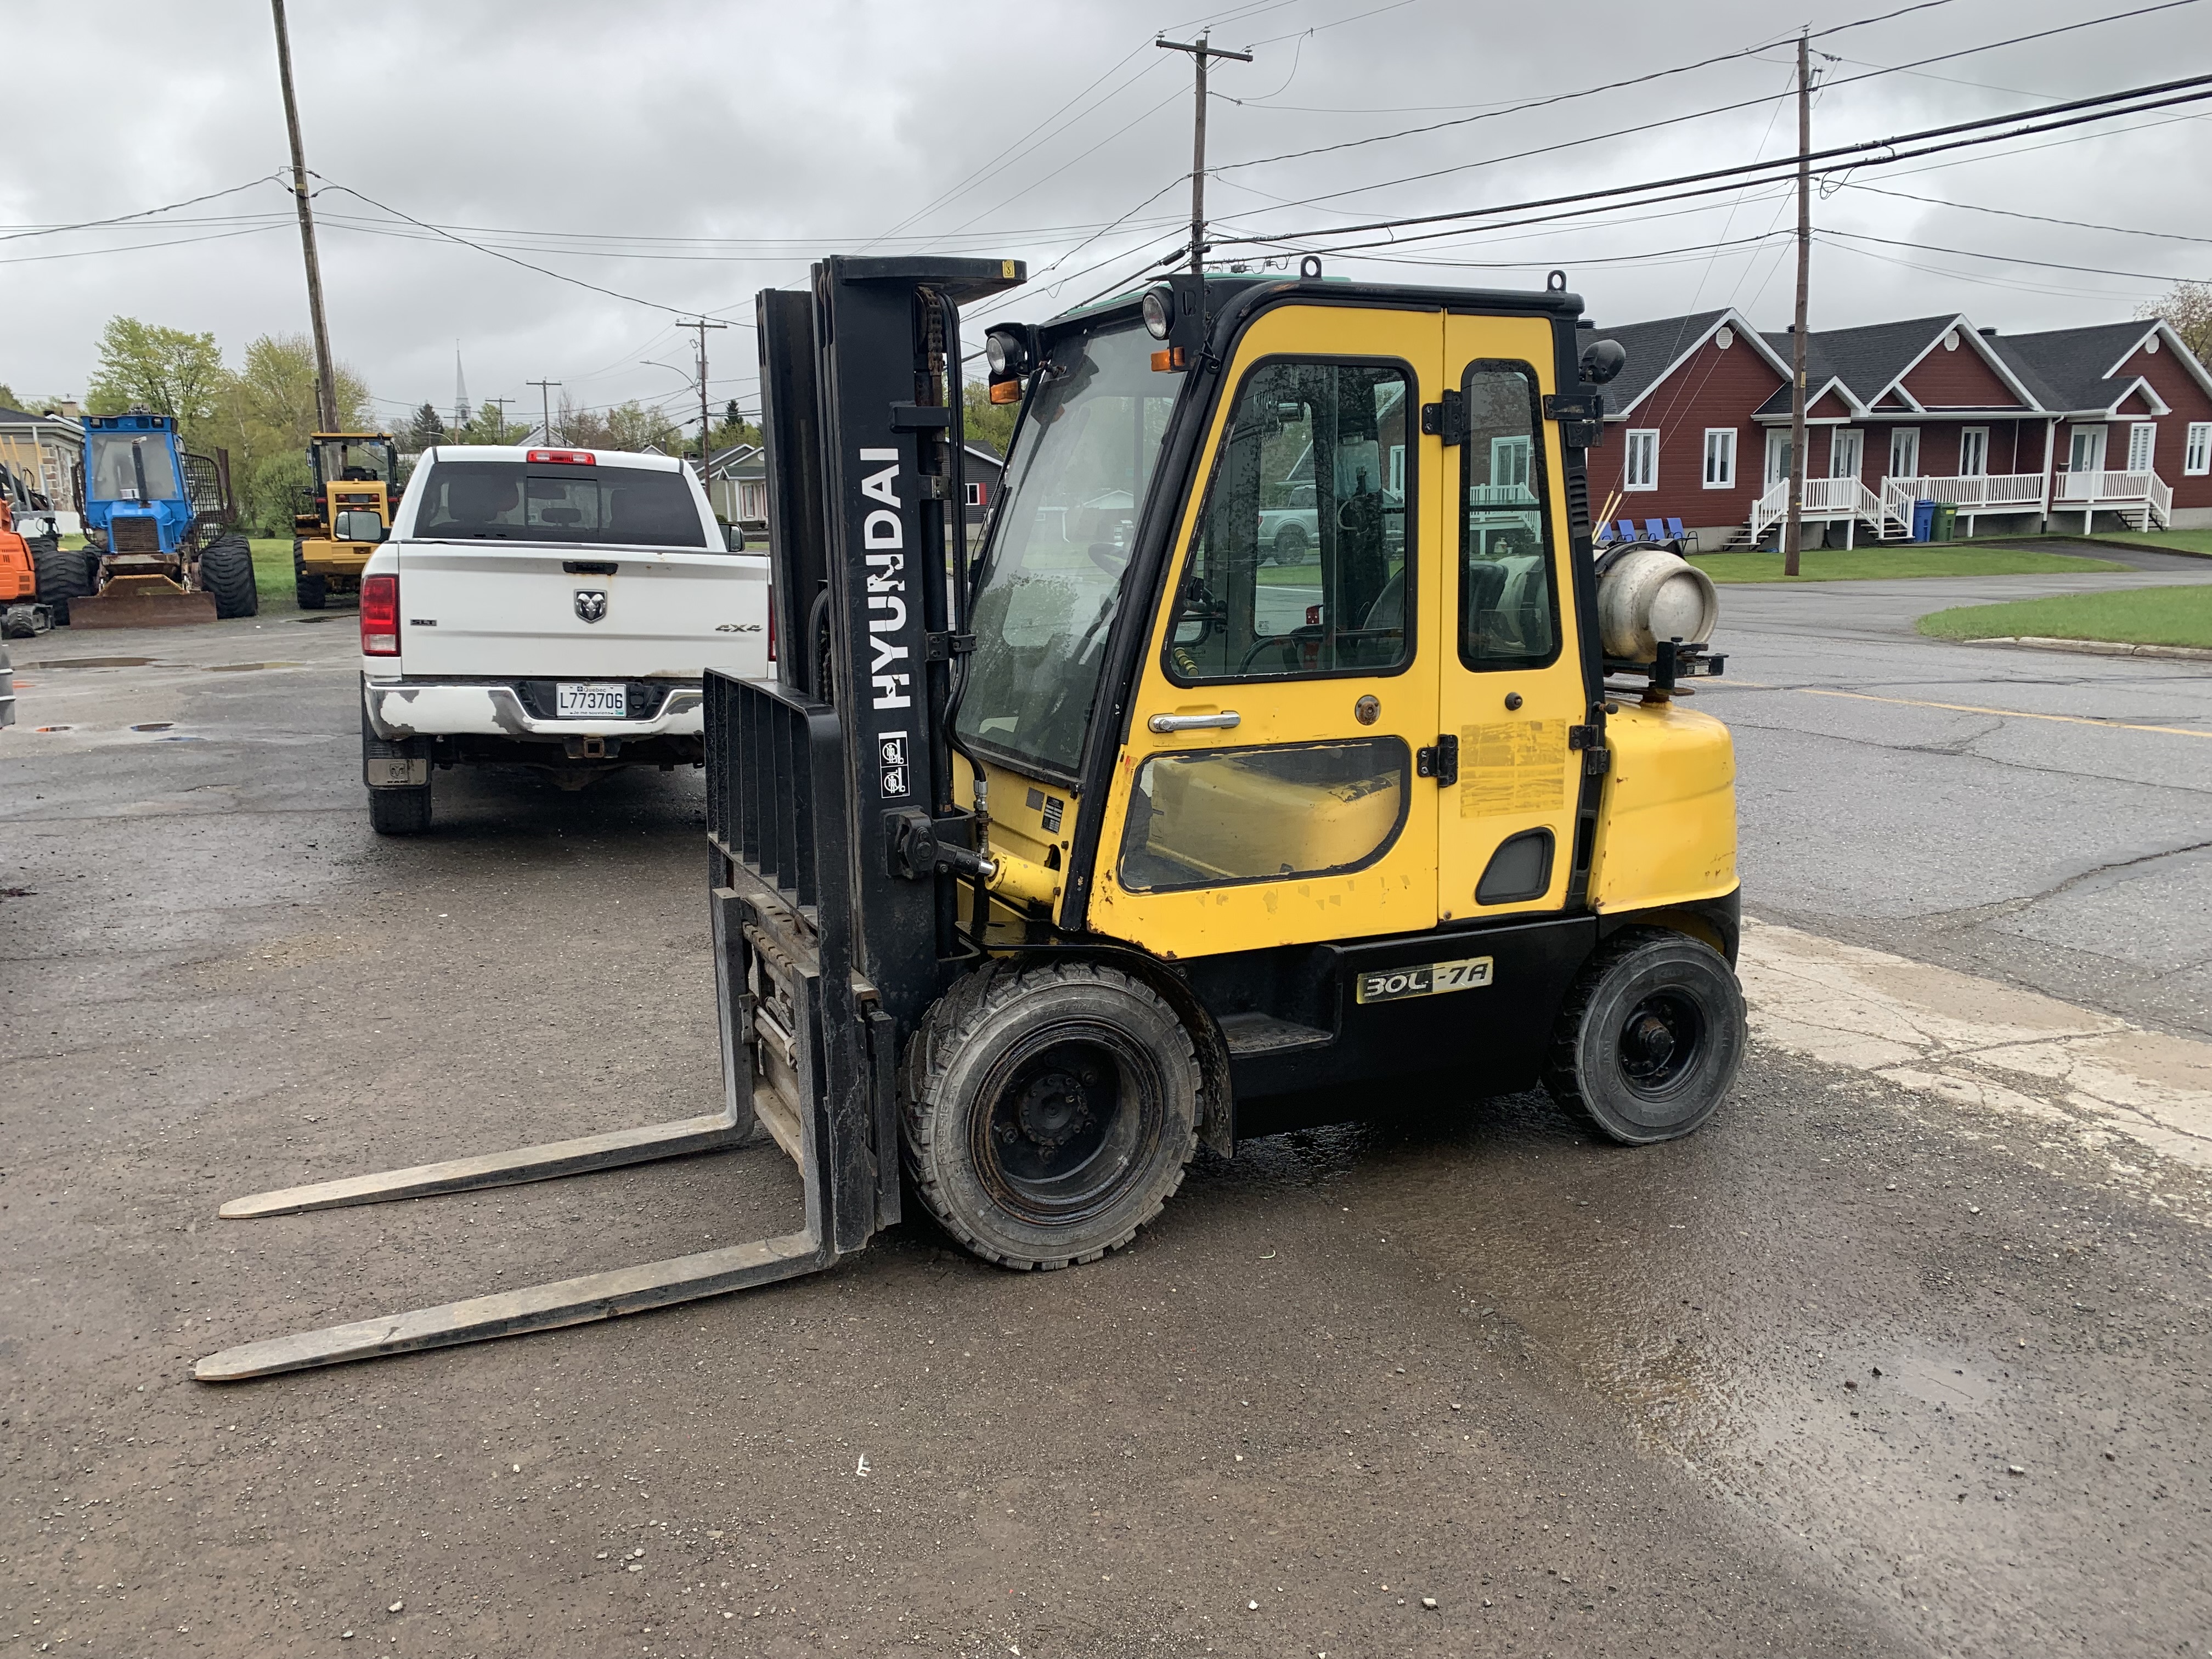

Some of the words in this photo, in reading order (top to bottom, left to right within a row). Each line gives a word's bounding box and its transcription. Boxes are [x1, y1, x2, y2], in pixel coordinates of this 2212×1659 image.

[859, 448, 911, 709] HYUNDAI
[560, 692, 623, 709] L773706
[1363, 963, 1488, 997] 30L-7A
